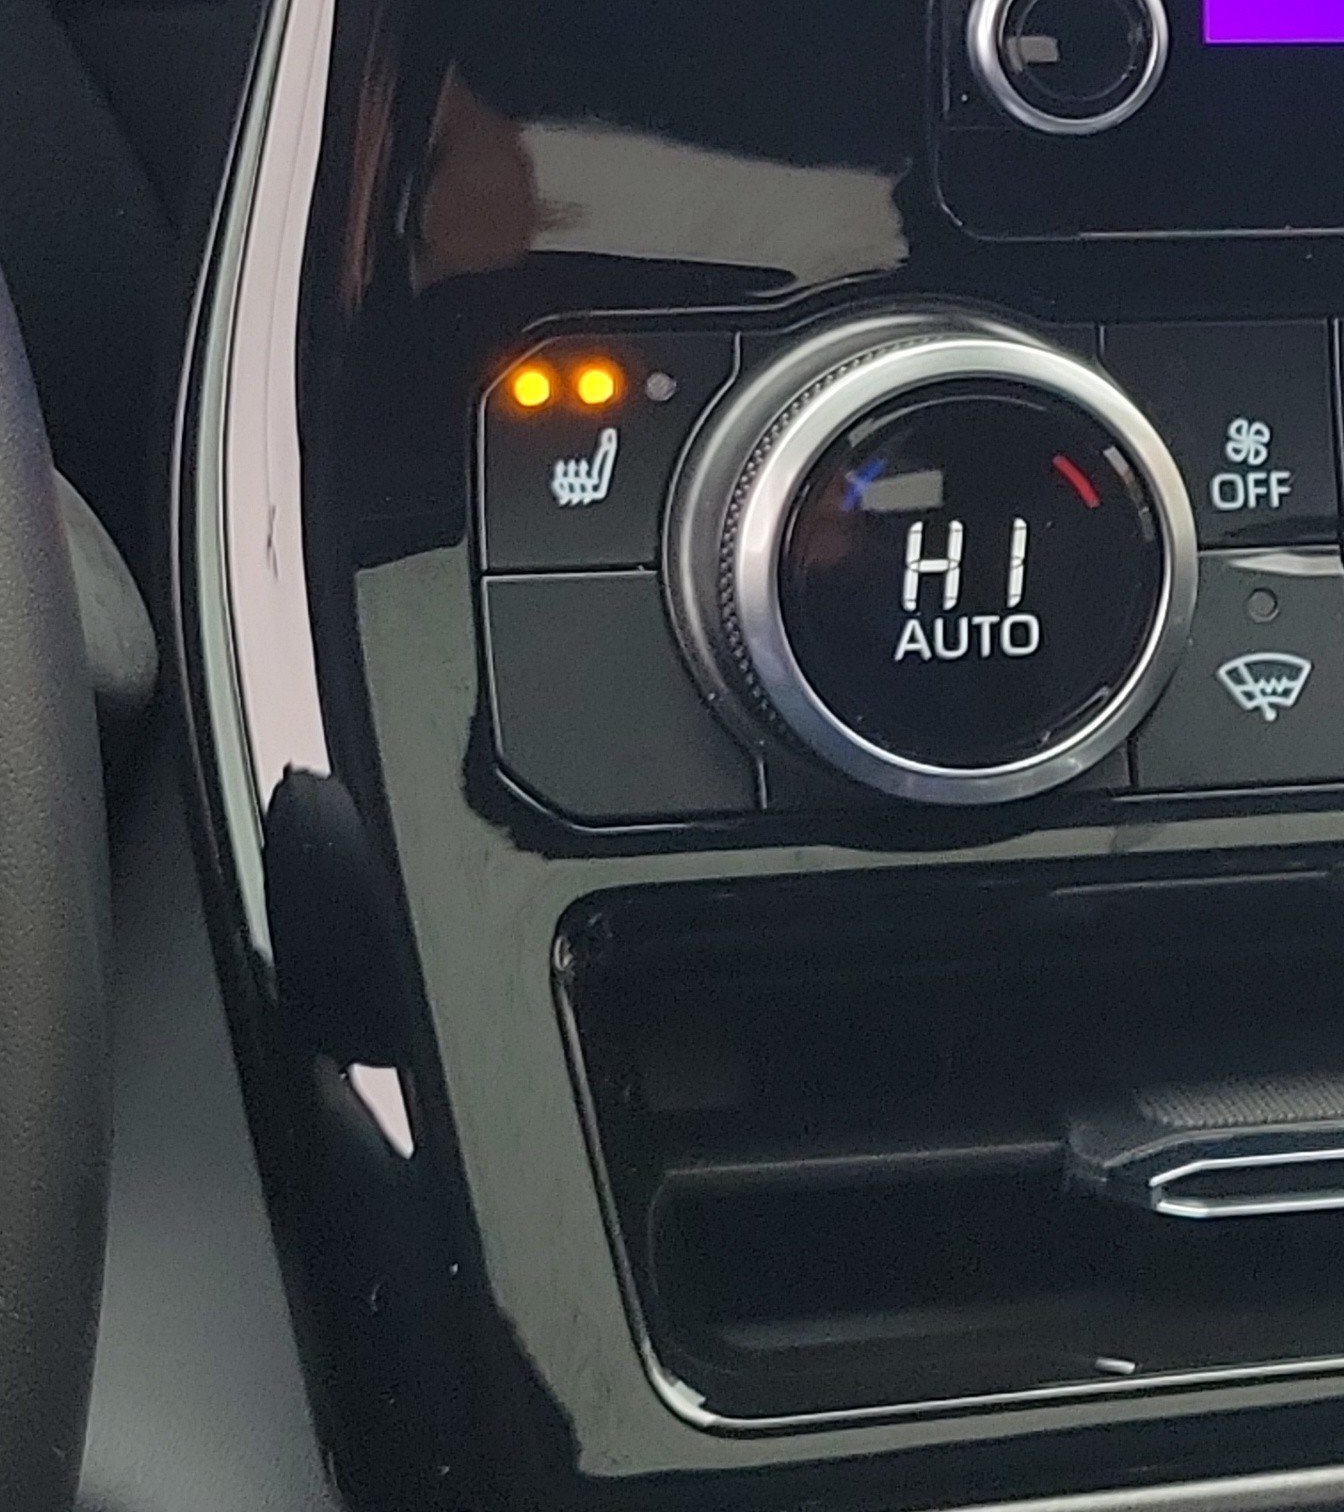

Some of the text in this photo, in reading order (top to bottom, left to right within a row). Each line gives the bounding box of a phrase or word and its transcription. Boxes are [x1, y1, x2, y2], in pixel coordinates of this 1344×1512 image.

[1210, 471, 1292, 510] OFF
[902, 518, 1028, 611] HI
[895, 612, 1041, 662] AUTO
